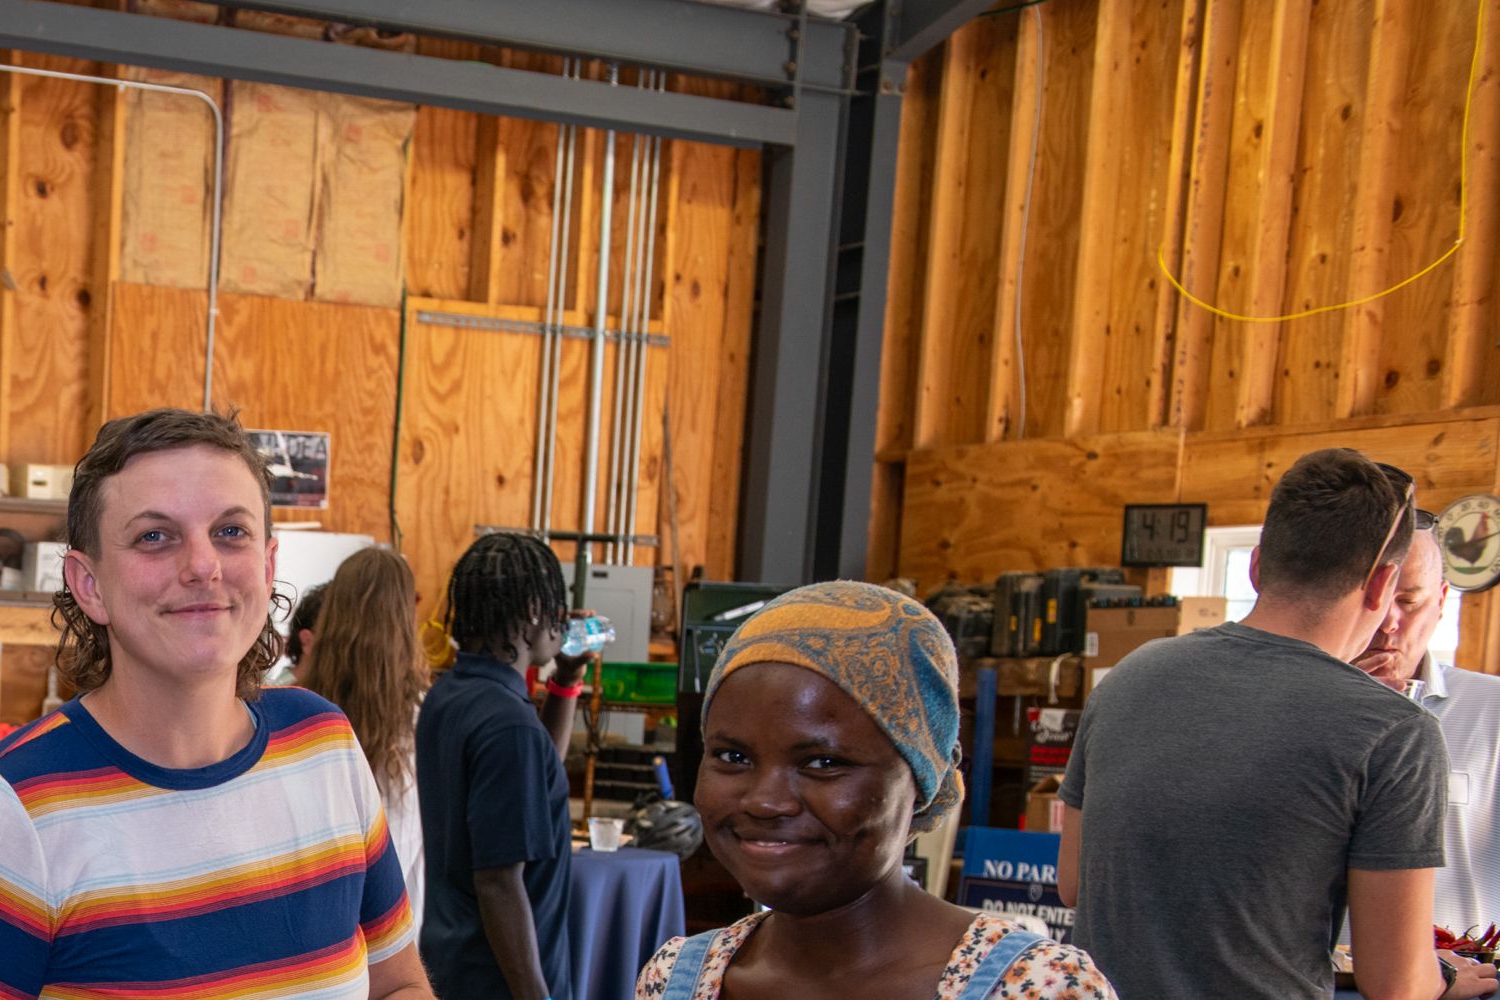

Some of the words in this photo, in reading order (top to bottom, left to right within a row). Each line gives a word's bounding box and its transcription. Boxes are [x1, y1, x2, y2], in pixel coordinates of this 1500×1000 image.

[1142, 510, 1190, 543] 4:19
[983, 859, 1013, 881] NO
[1016, 862, 1059, 884] PAR
[1037, 904, 1076, 926] ENTE
